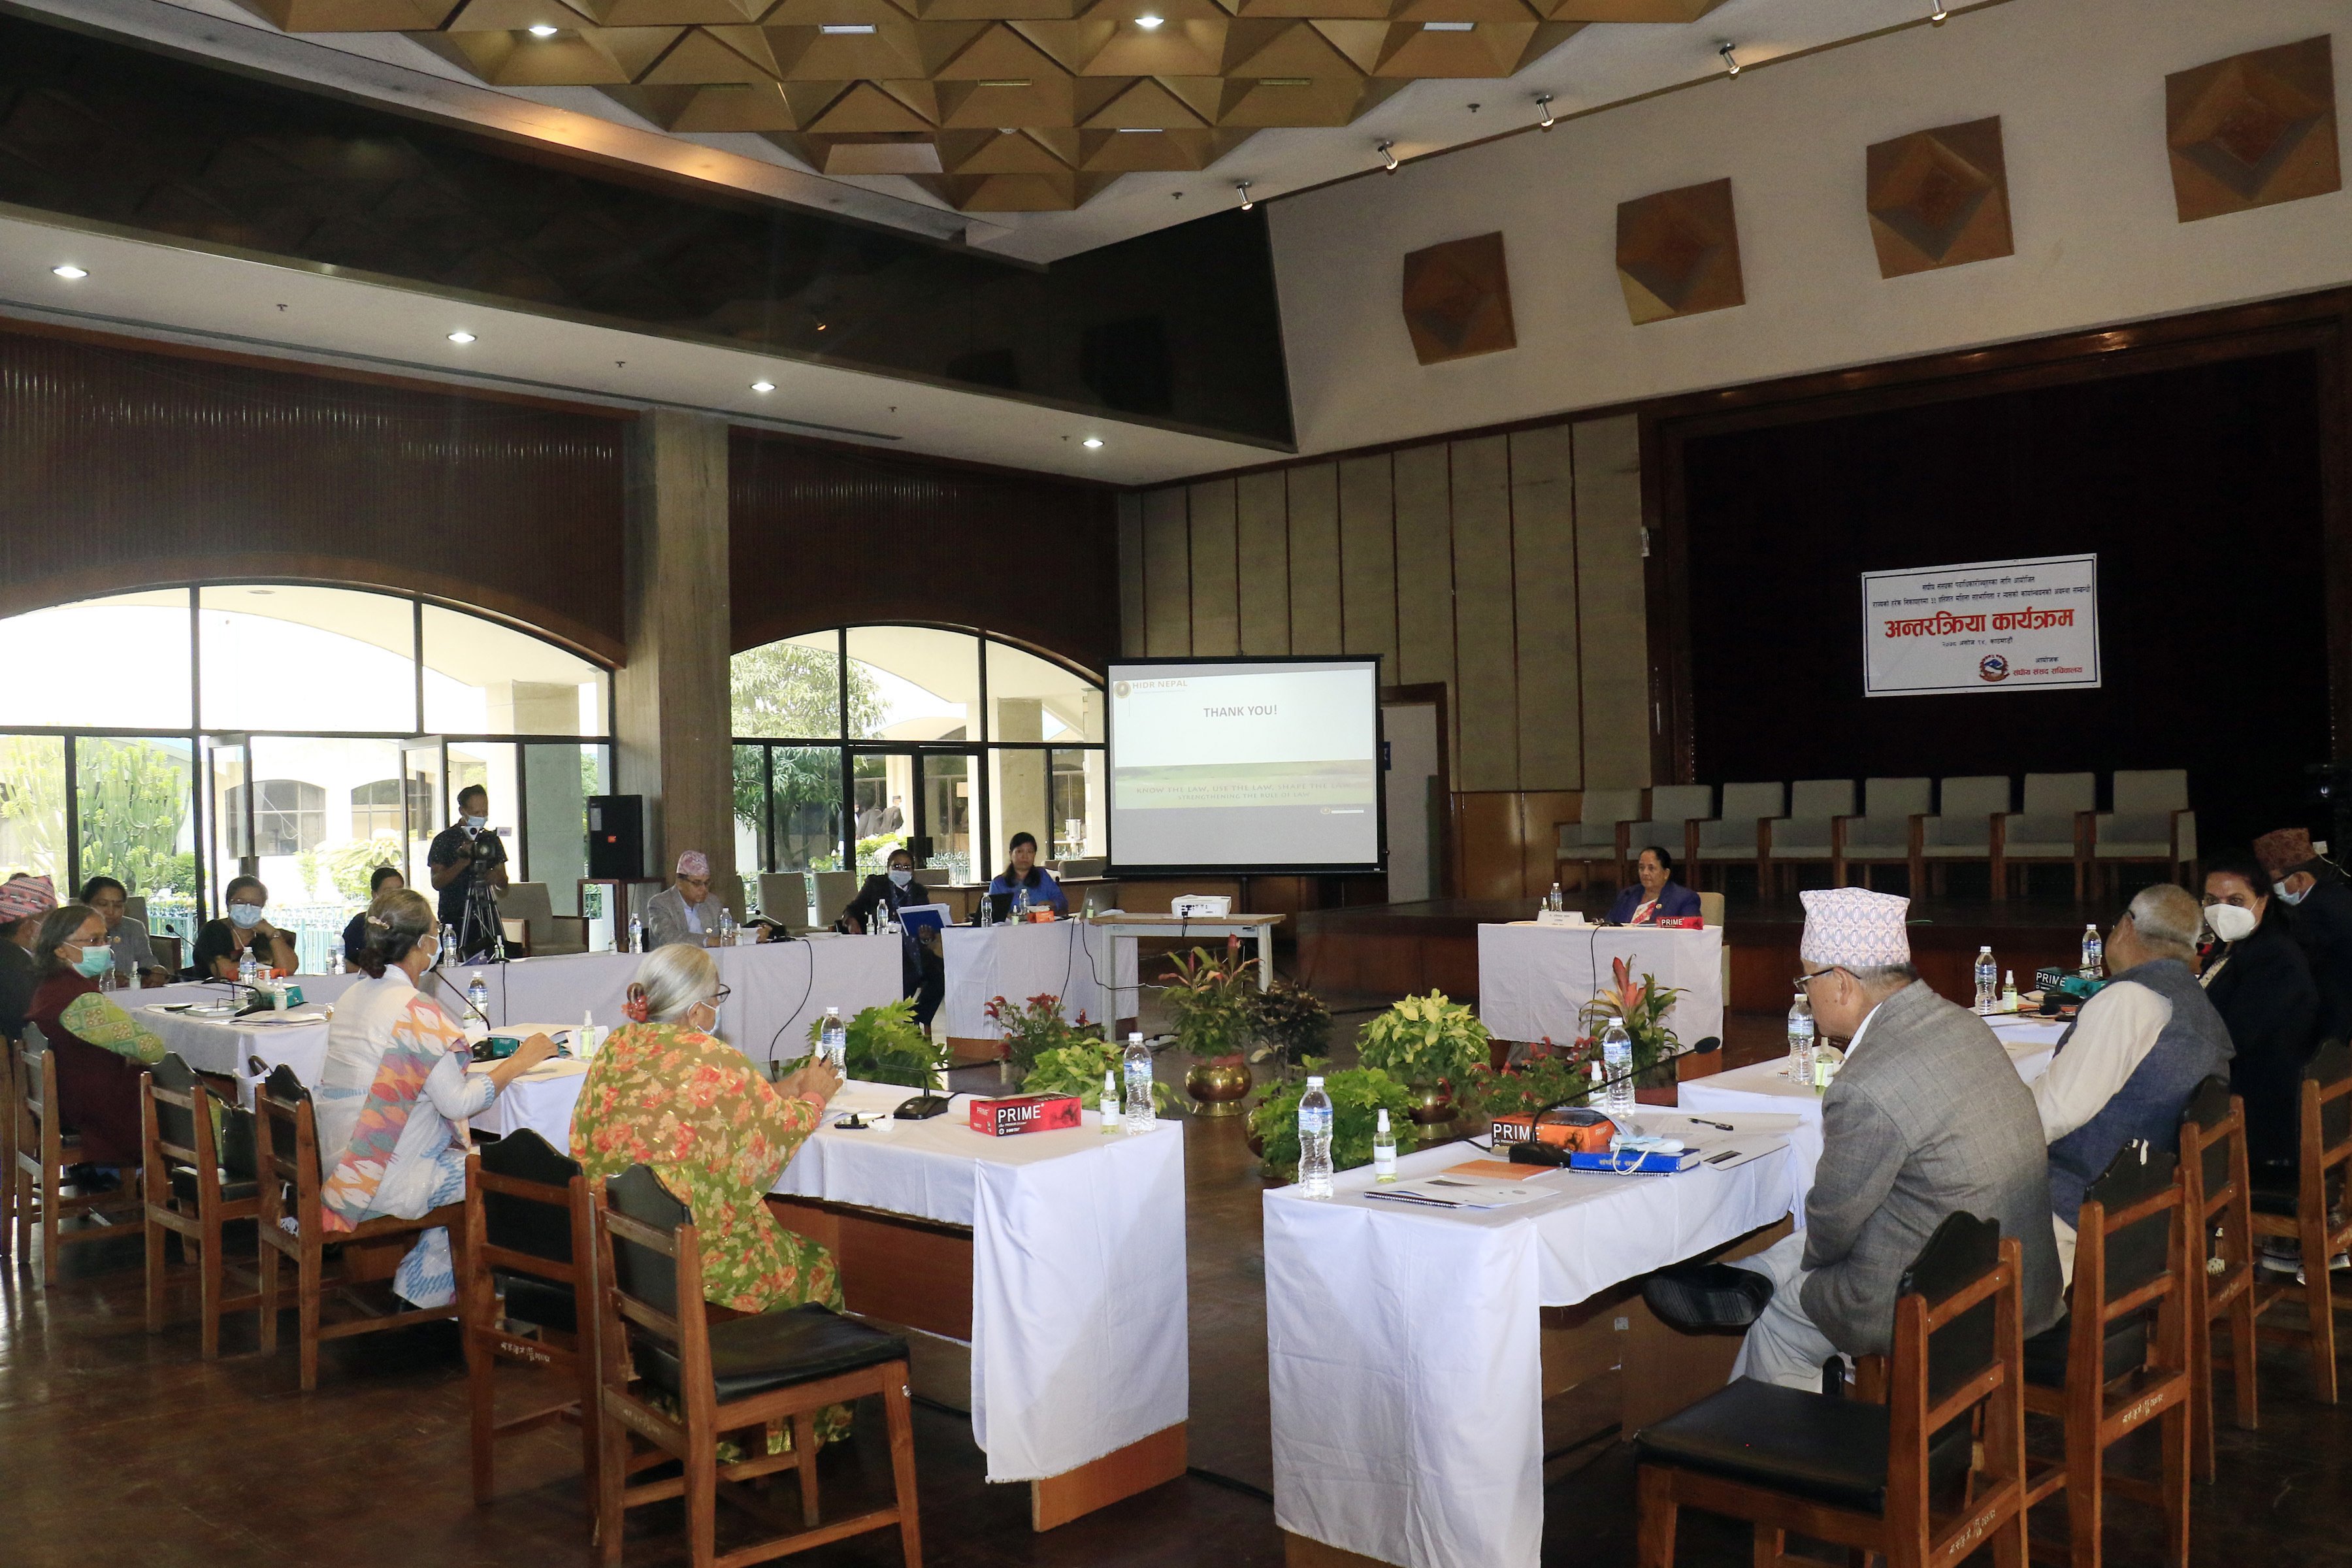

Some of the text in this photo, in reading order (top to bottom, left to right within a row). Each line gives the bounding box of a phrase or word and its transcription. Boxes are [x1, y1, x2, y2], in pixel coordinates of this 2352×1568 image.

[1884, 606, 2075, 638] अन्तरक्रिया कार्यक्रम
[1132, 679, 1188, 689] HIDR NEPAL
[1203, 704, 1277, 718] THANK YOU!
[998, 1105, 1041, 1124] PRIME
